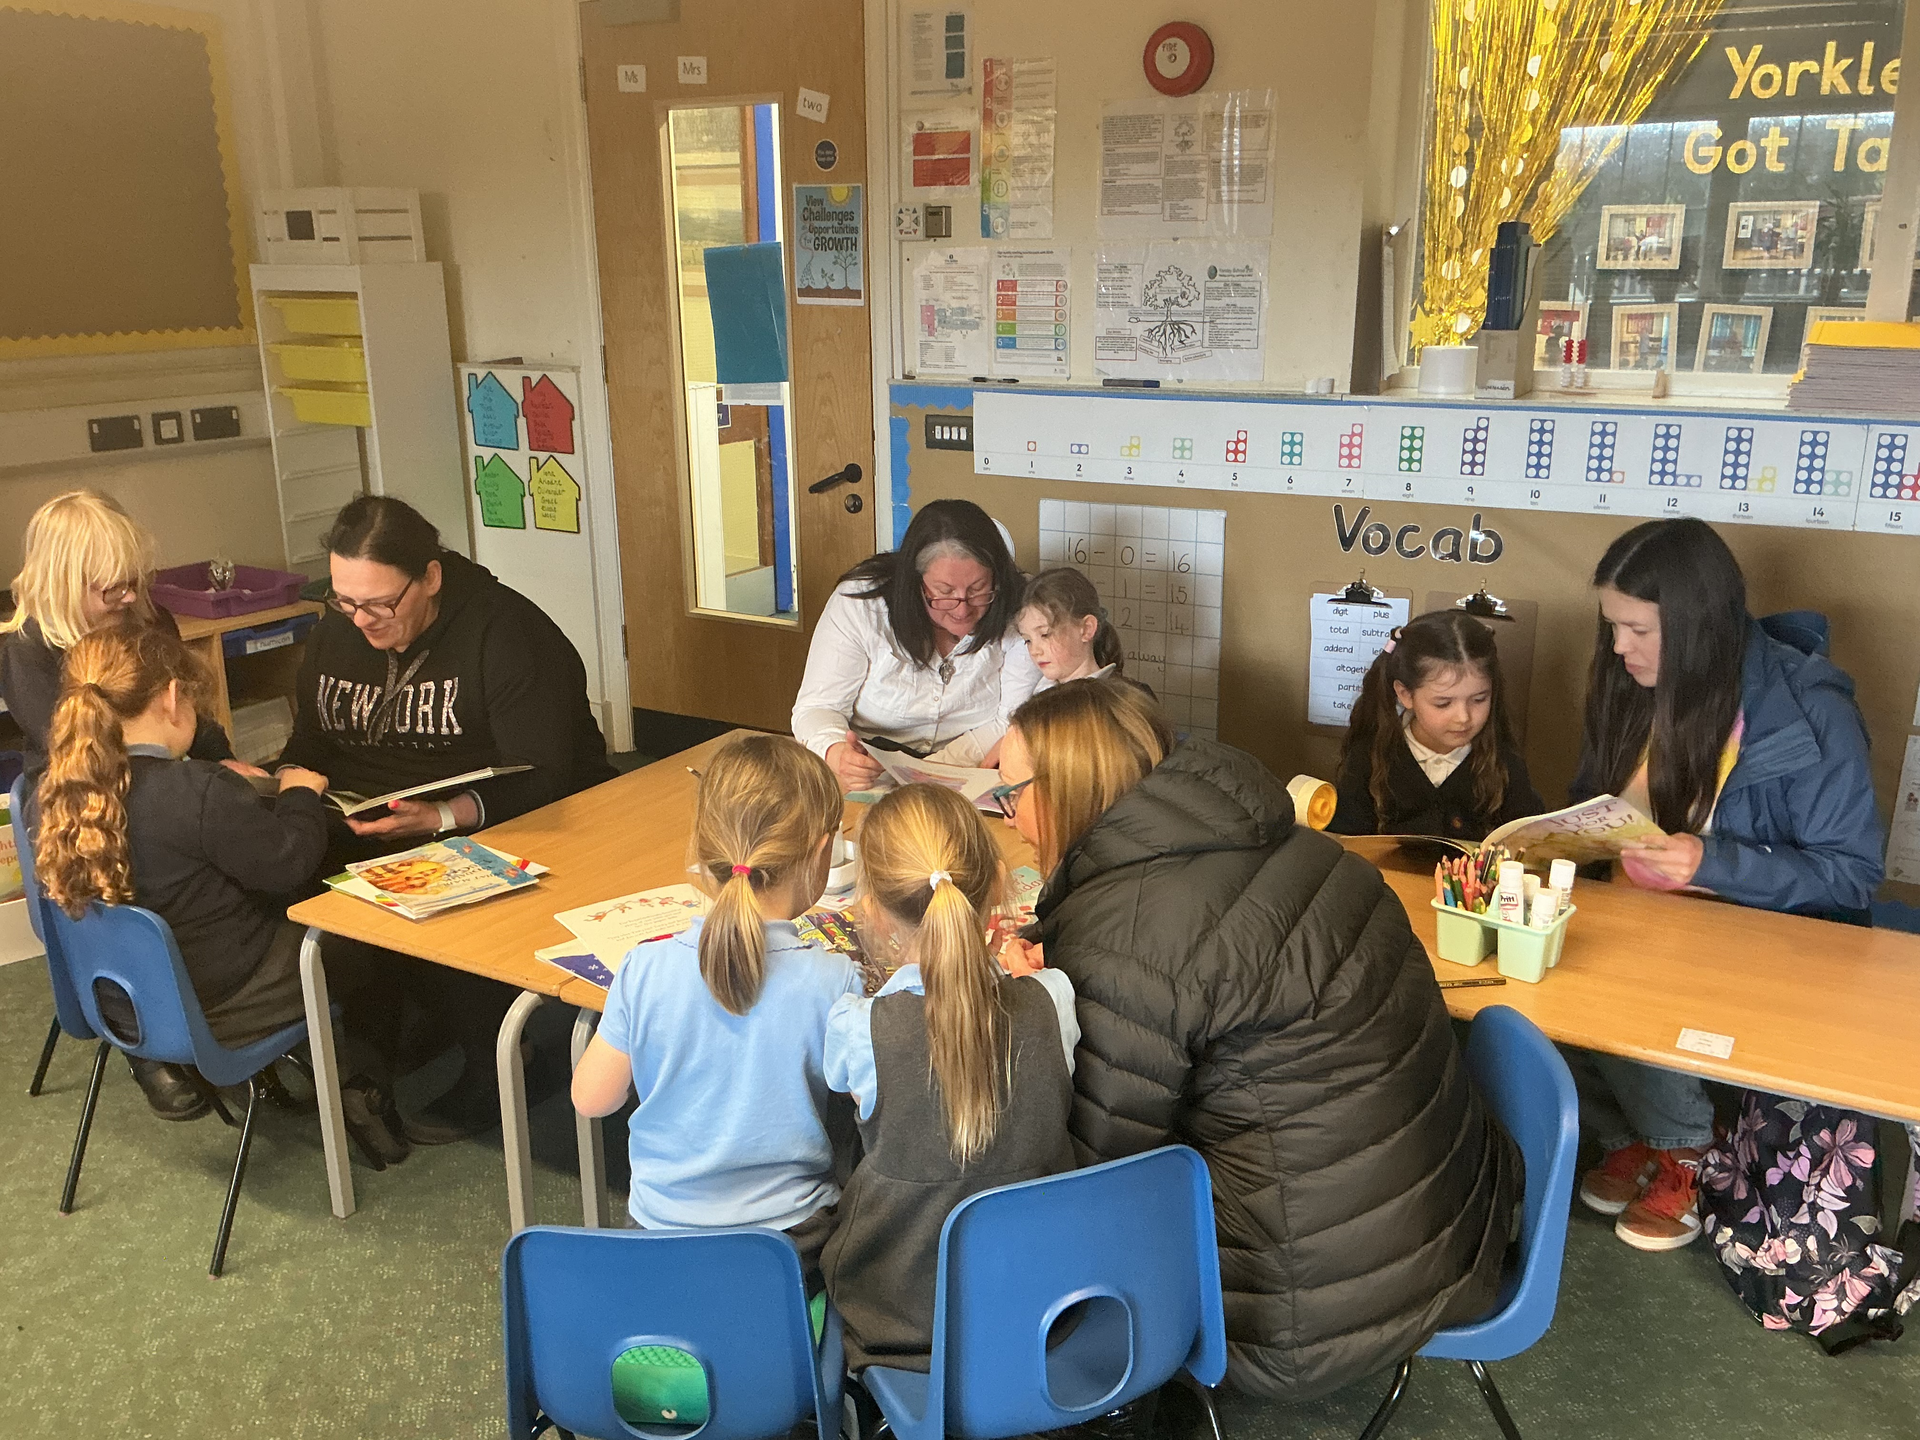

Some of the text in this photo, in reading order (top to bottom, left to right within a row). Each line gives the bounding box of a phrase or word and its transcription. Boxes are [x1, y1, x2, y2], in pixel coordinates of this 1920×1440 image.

[625, 70, 638, 83] Ms
[683, 62, 701, 75] Mrs
[1725, 40, 1901, 99] Yorkle
[803, 97, 822, 113] two
[1684, 126, 1790, 175] Got
[805, 195, 824, 207] View
[803, 207, 855, 225] Challenges
[809, 223, 859, 237] Opportunities
[814, 236, 858, 252] GROWTH
[984, 457, 989, 465] 0
[1077, 464, 1082, 472] 2
[1127, 467, 1132, 475] 3
[1232, 473, 1238, 481] 5
[1287, 476, 1293, 484] 6
[1346, 479, 1352, 487] 7
[1405, 482, 1411, 491] 8
[1467, 486, 1474, 495] 9
[1530, 490, 1540, 499] 10
[1599, 494, 1606, 503] 11
[1667, 498, 1678, 507] 12
[1739, 502, 1749, 512] 13
[1813, 507, 1824, 517] 14
[1889, 511, 1902, 521] 15
[1333, 504, 1503, 564] Vocab
[1067, 537, 1087, 564] 16
[1120, 545, 1134, 565] 0
[1145, 552, 1156, 563] =
[1172, 551, 1190, 573] 16
[1170, 583, 1188, 604] 15
[1121, 607, 1132, 627] 2
[1169, 614, 1189, 635] 14
[1332, 607, 1390, 619] digit plus
[1329, 626, 1390, 638] total subtra
[1323, 644, 1384, 656] addend lef
[1127, 651, 1166, 672] away
[1336, 664, 1369, 674] altogeth
[1338, 684, 1362, 692] partit
[1333, 701, 1352, 710] take
[1548, 801, 1617, 827] JUST
[1575, 816, 1609, 828] FOR
[1564, 814, 1634, 836] YOU!
